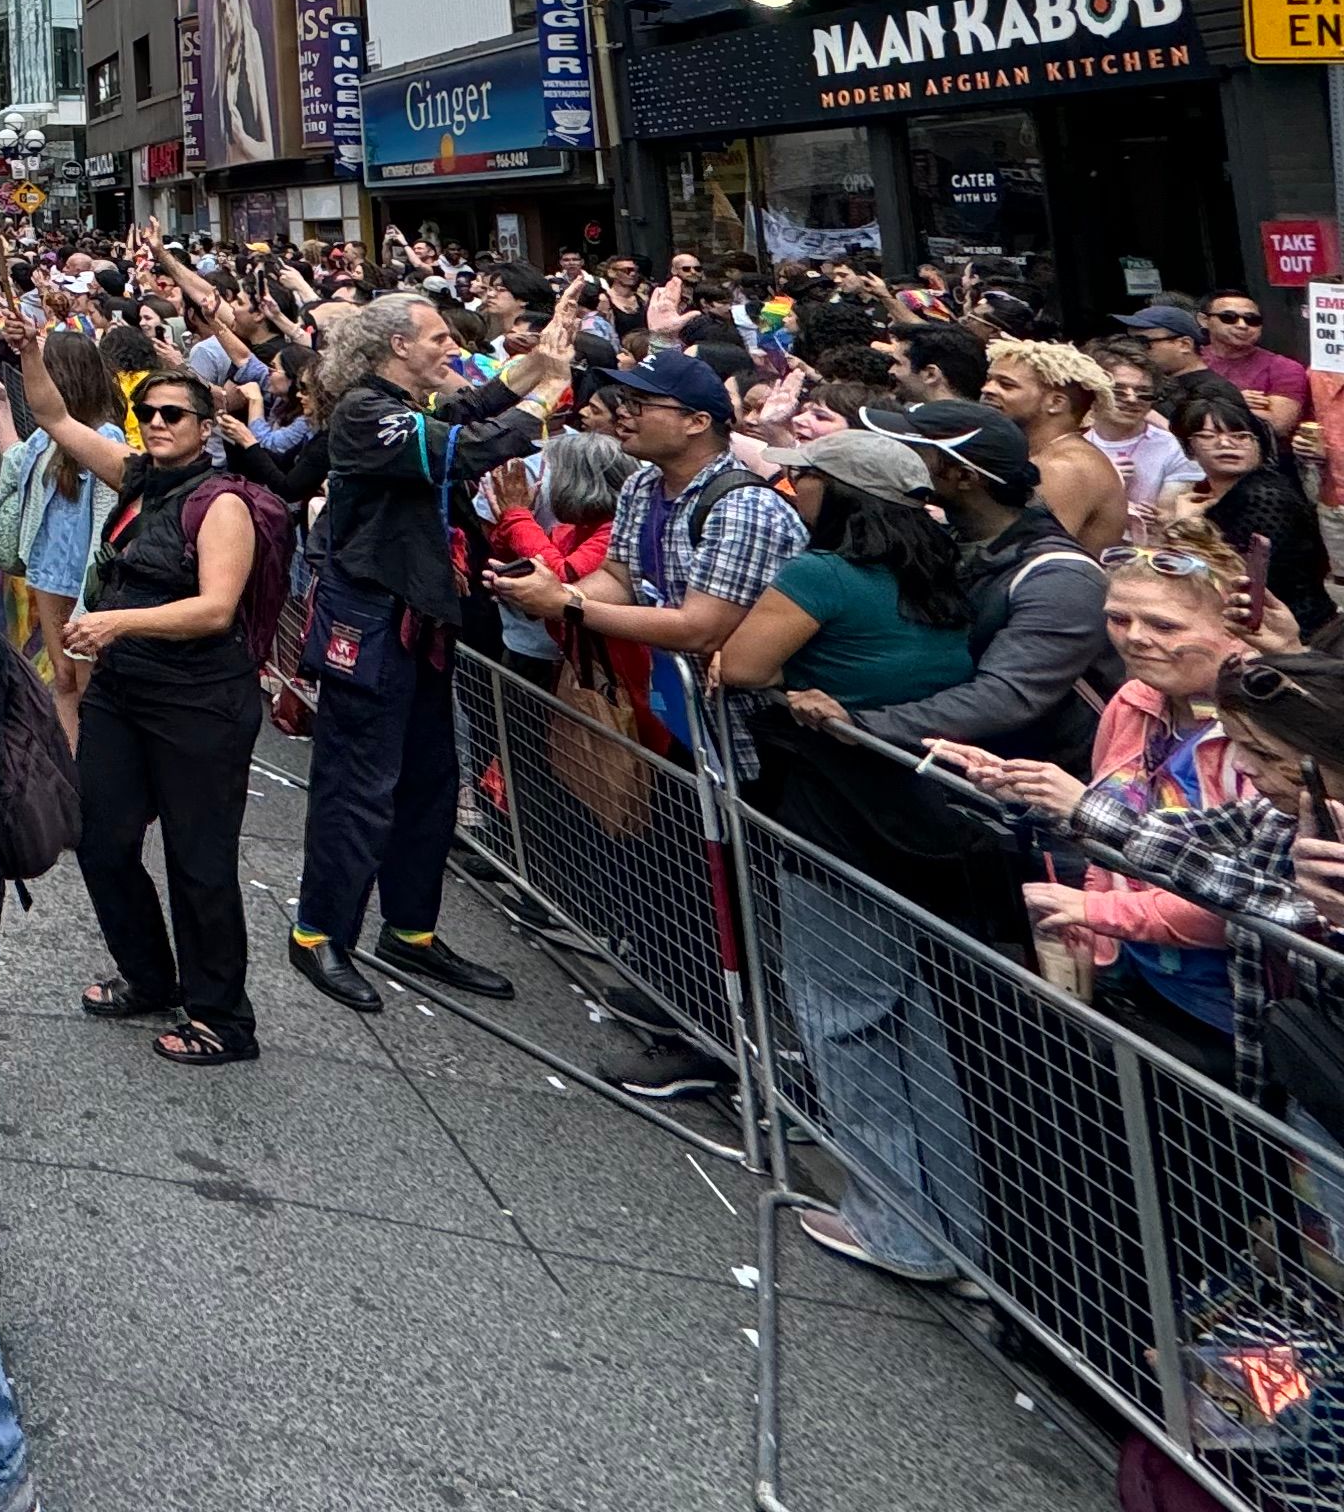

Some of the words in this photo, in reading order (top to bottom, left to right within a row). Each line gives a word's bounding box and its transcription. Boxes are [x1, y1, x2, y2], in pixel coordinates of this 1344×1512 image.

[812, 4, 947, 77] NAAN
[332, 22, 360, 119] GINGER
[821, 82, 911, 109] MODERN
[925, 66, 1031, 96] AFGHAN
[1046, 45, 1190, 82] KITCHEN
[405, 79, 493, 137] Ginger
[951, 173, 996, 189] CATER
[953, 192, 981, 204] WITH
[983, 191, 998, 203] US
[1270, 234, 1317, 252] TAKE
[1279, 255, 1313, 273] OUT
[1316, 312, 1337, 325] NO
